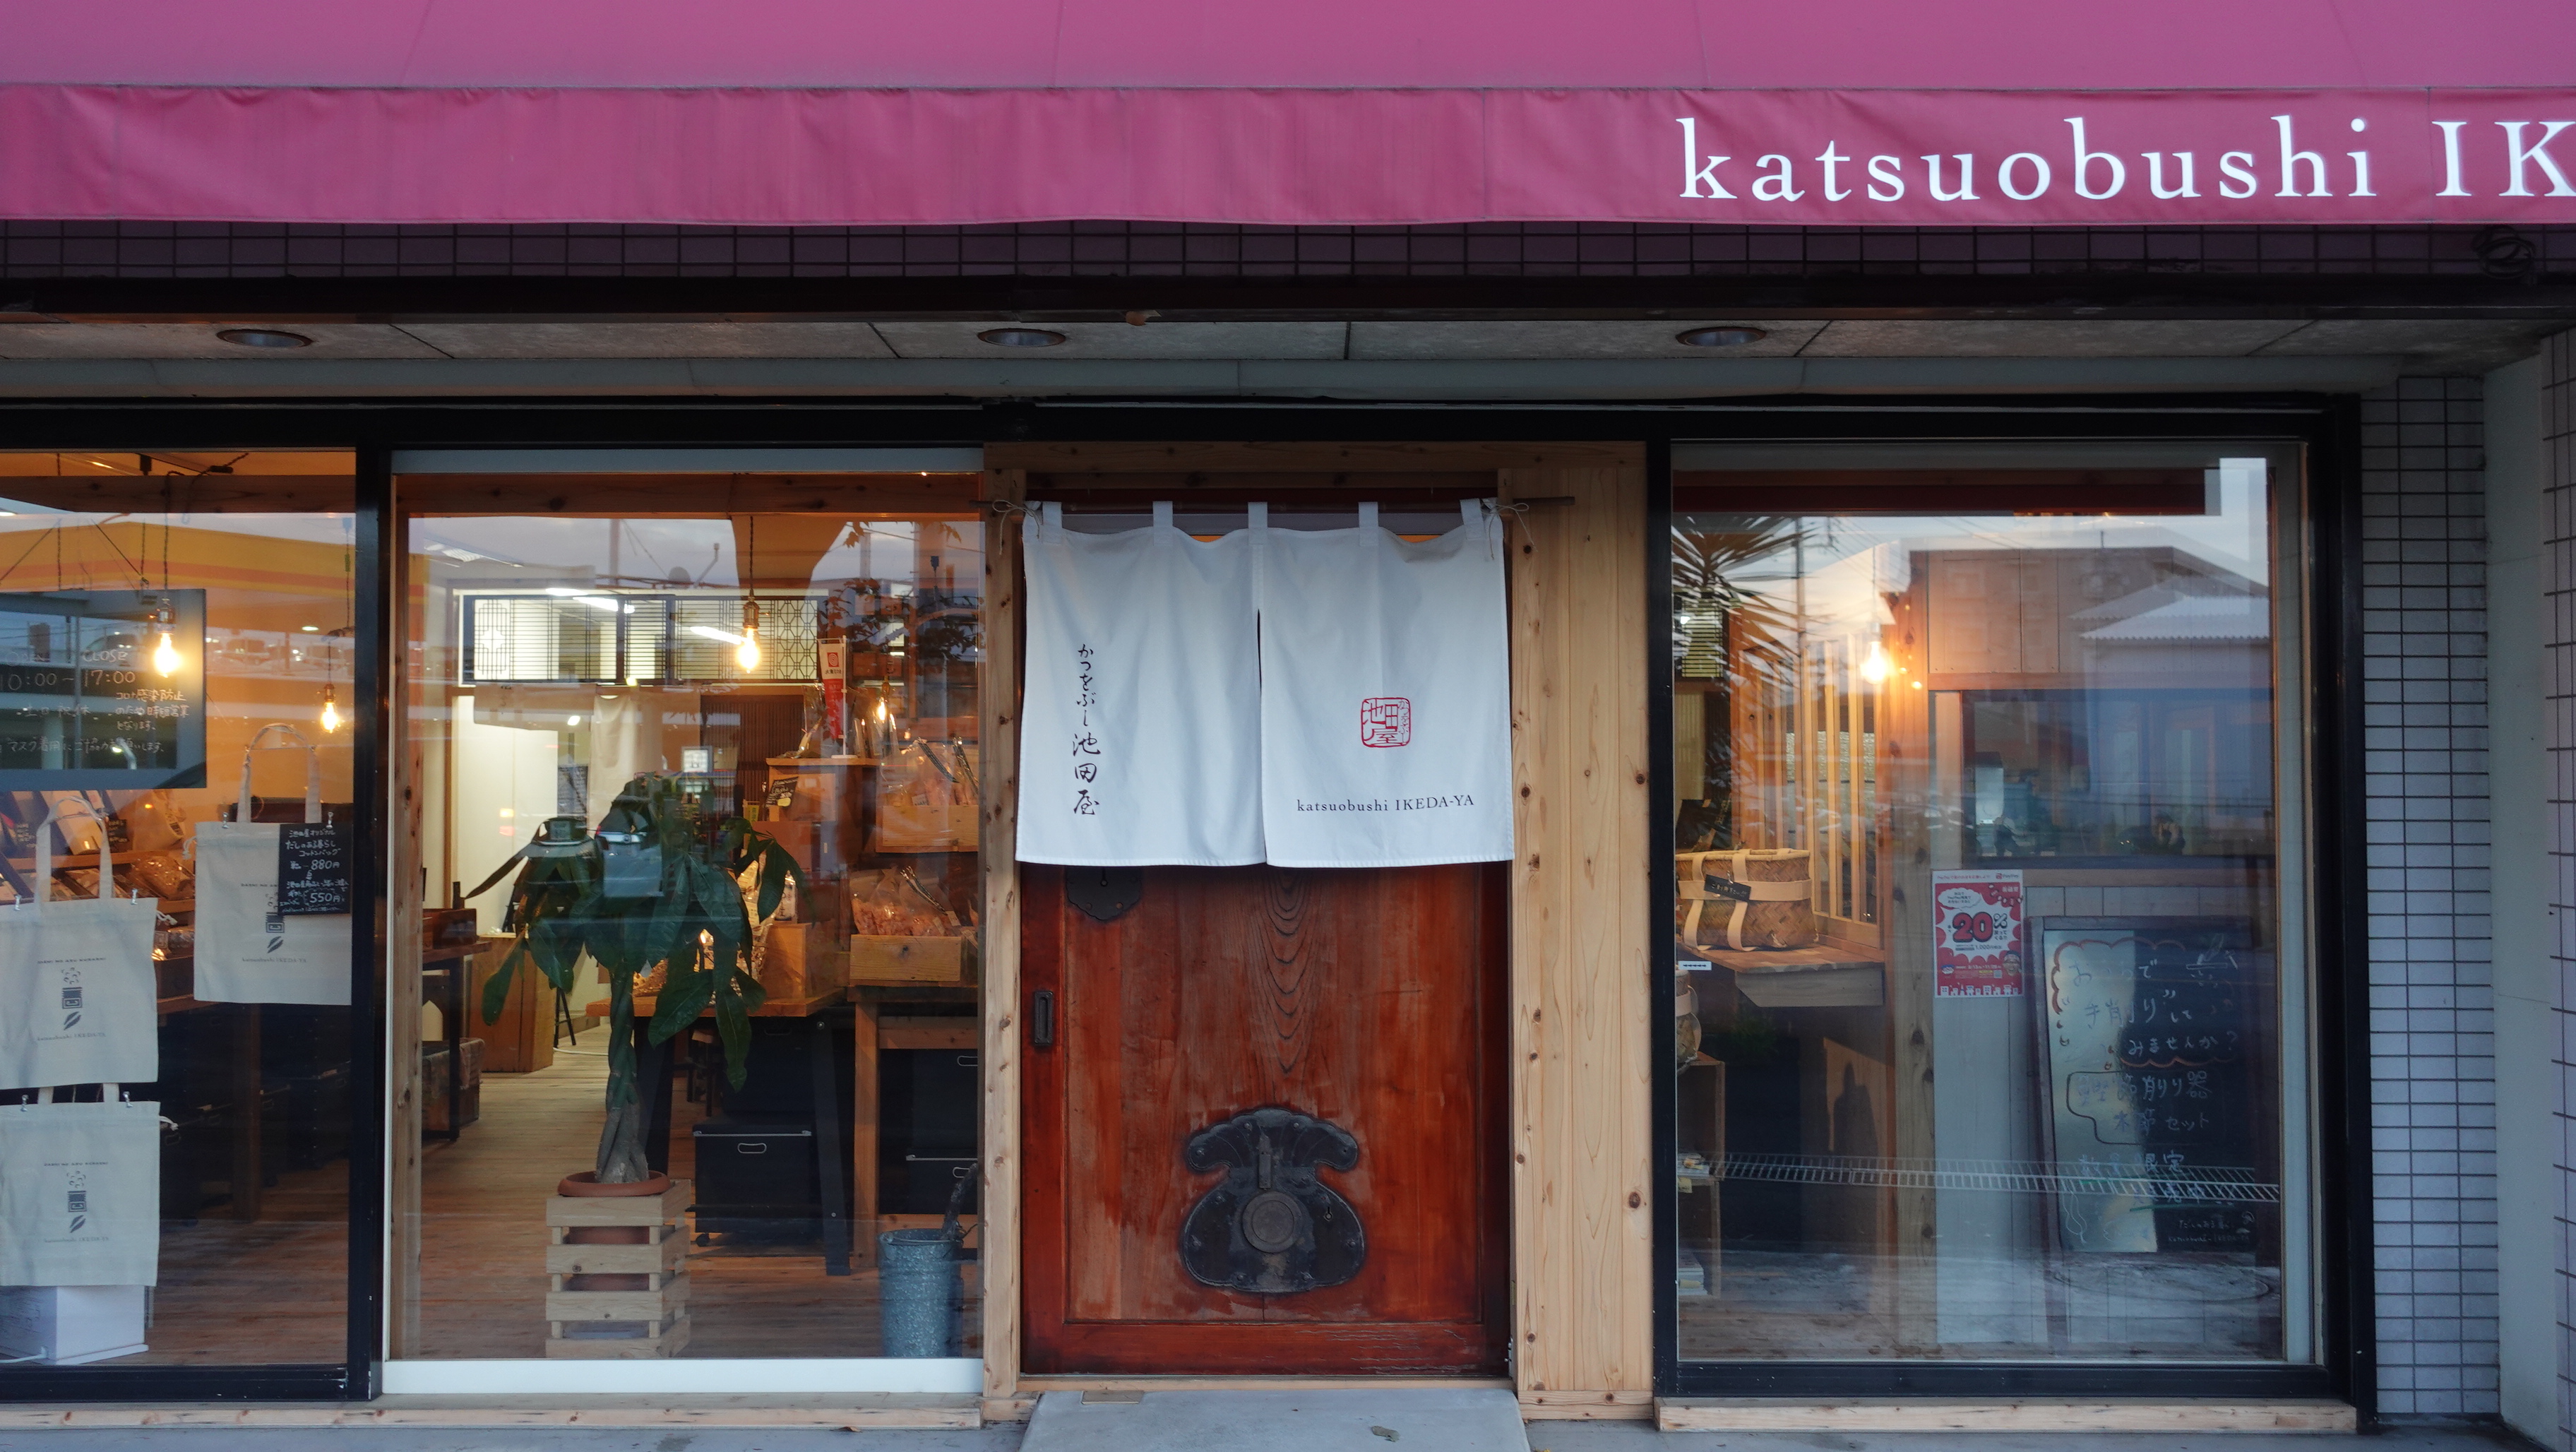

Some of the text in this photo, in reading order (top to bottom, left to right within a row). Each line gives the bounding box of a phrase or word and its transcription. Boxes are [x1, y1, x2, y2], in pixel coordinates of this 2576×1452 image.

[1675, 114, 2378, 202] katsuobushi
[1296, 794, 1475, 811] katsuobushi IKEDA-YA
[1952, 911, 2008, 943] 20%
